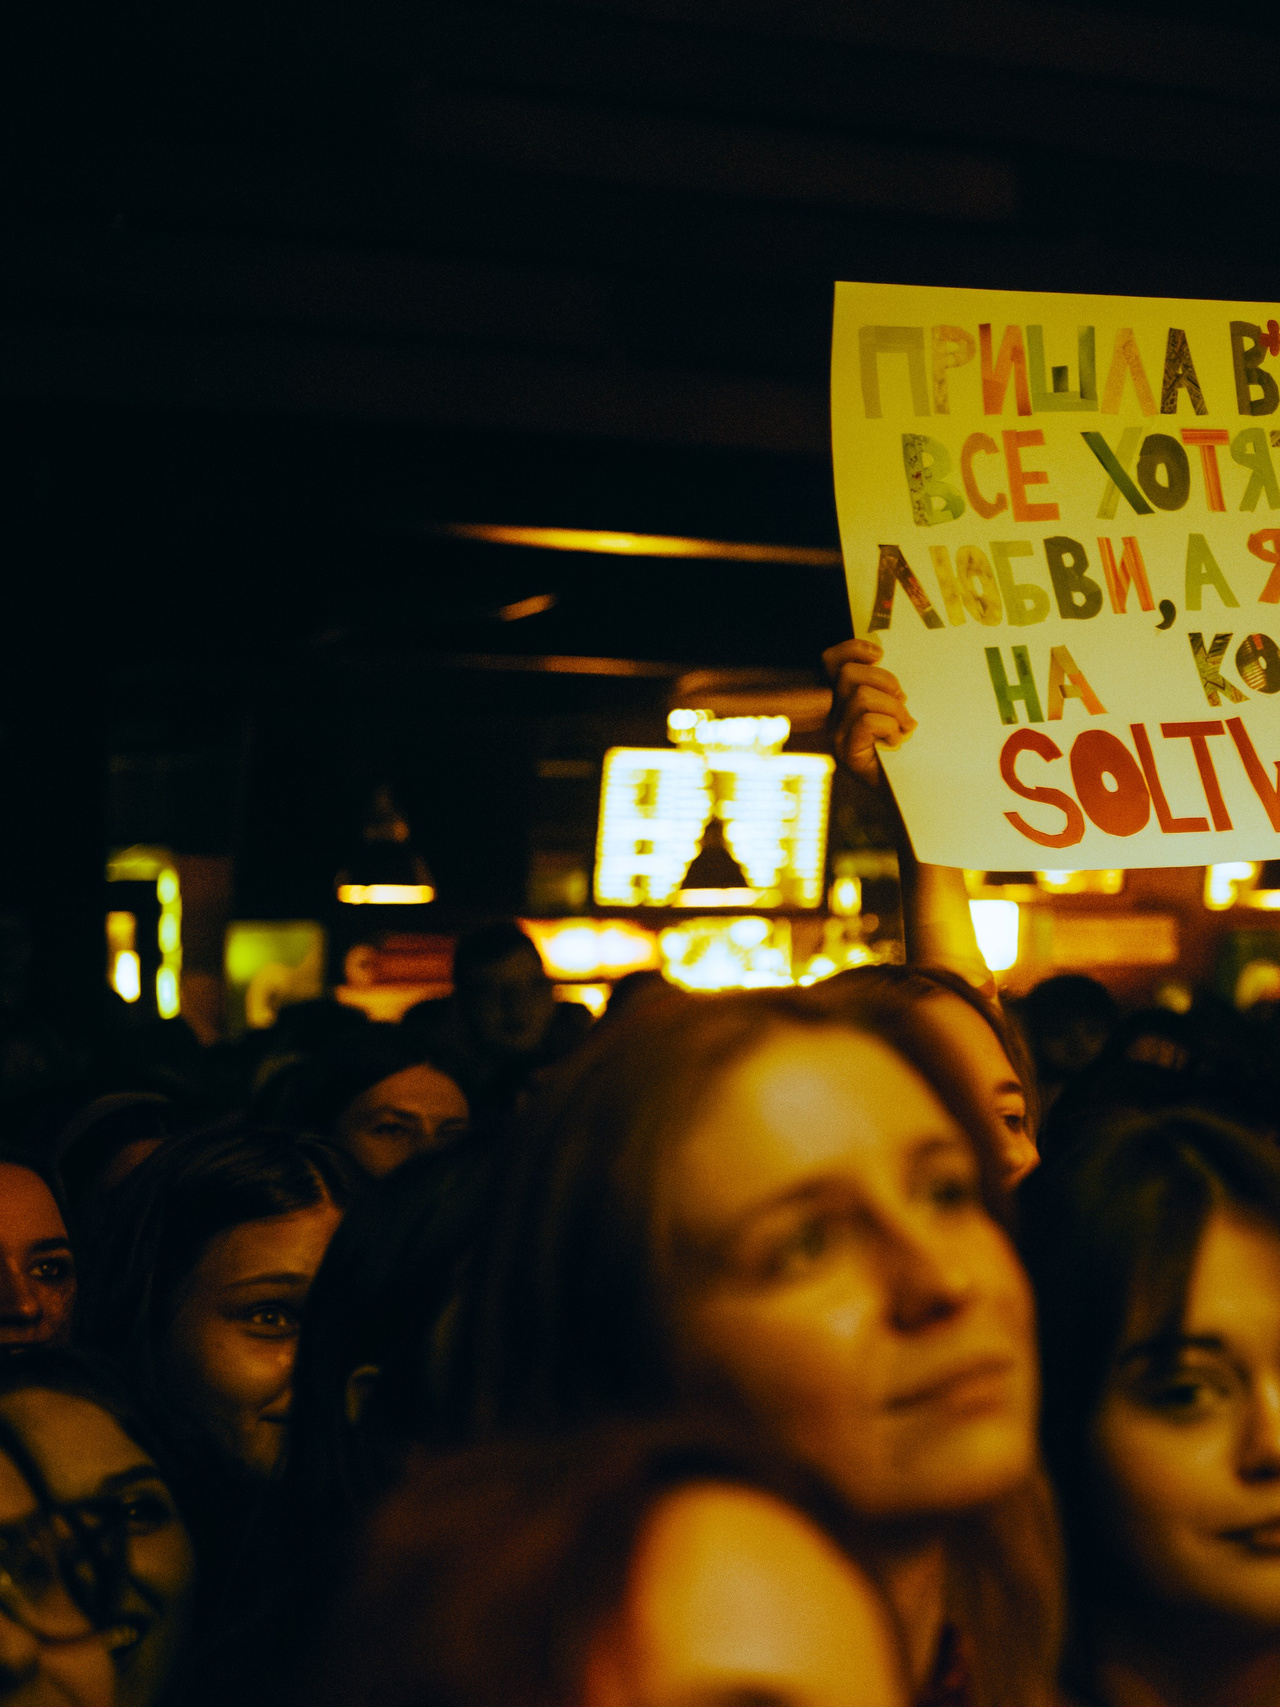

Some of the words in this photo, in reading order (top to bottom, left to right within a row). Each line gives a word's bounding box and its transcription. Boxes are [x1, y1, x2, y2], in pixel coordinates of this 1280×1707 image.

[858, 323, 1208, 418] ПРИШЛА
[901, 429, 1060, 527] ВСЕ
[868, 535, 1177, 632] ЛЮБВИ,
[1185, 533, 1240, 608] А
[985, 644, 1108, 726] НА
